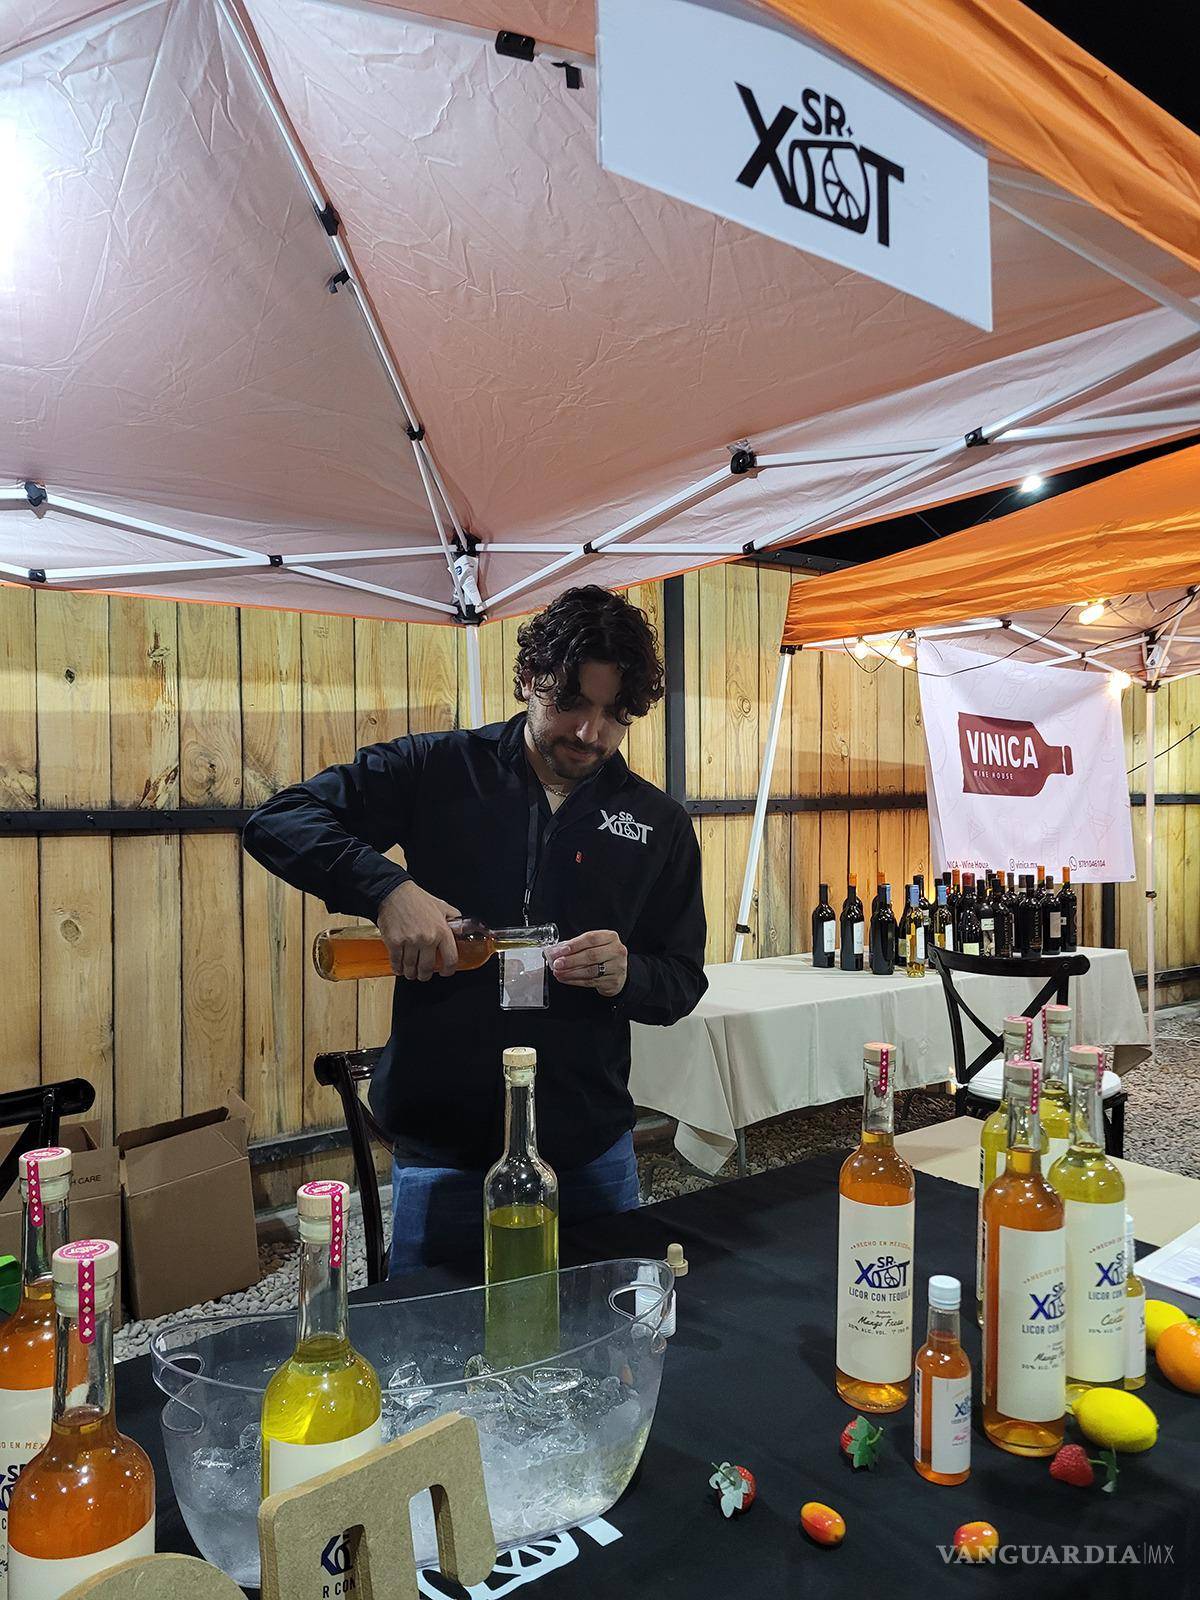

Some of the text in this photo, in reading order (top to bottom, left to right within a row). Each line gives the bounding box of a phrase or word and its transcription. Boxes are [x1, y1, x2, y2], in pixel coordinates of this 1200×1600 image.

[966, 729, 1039, 769] VINICA
[973, 770, 1014, 780] WINE HOUSE
[961, 860, 974, 868] Wine
[78, 1175, 102, 1184] CARE
[849, 1287, 869, 1300] LICOR
[871, 1293, 886, 1302] CON
[1088, 1291, 1110, 1300] LICOR
[1021, 1324, 1045, 1335] LICOR
